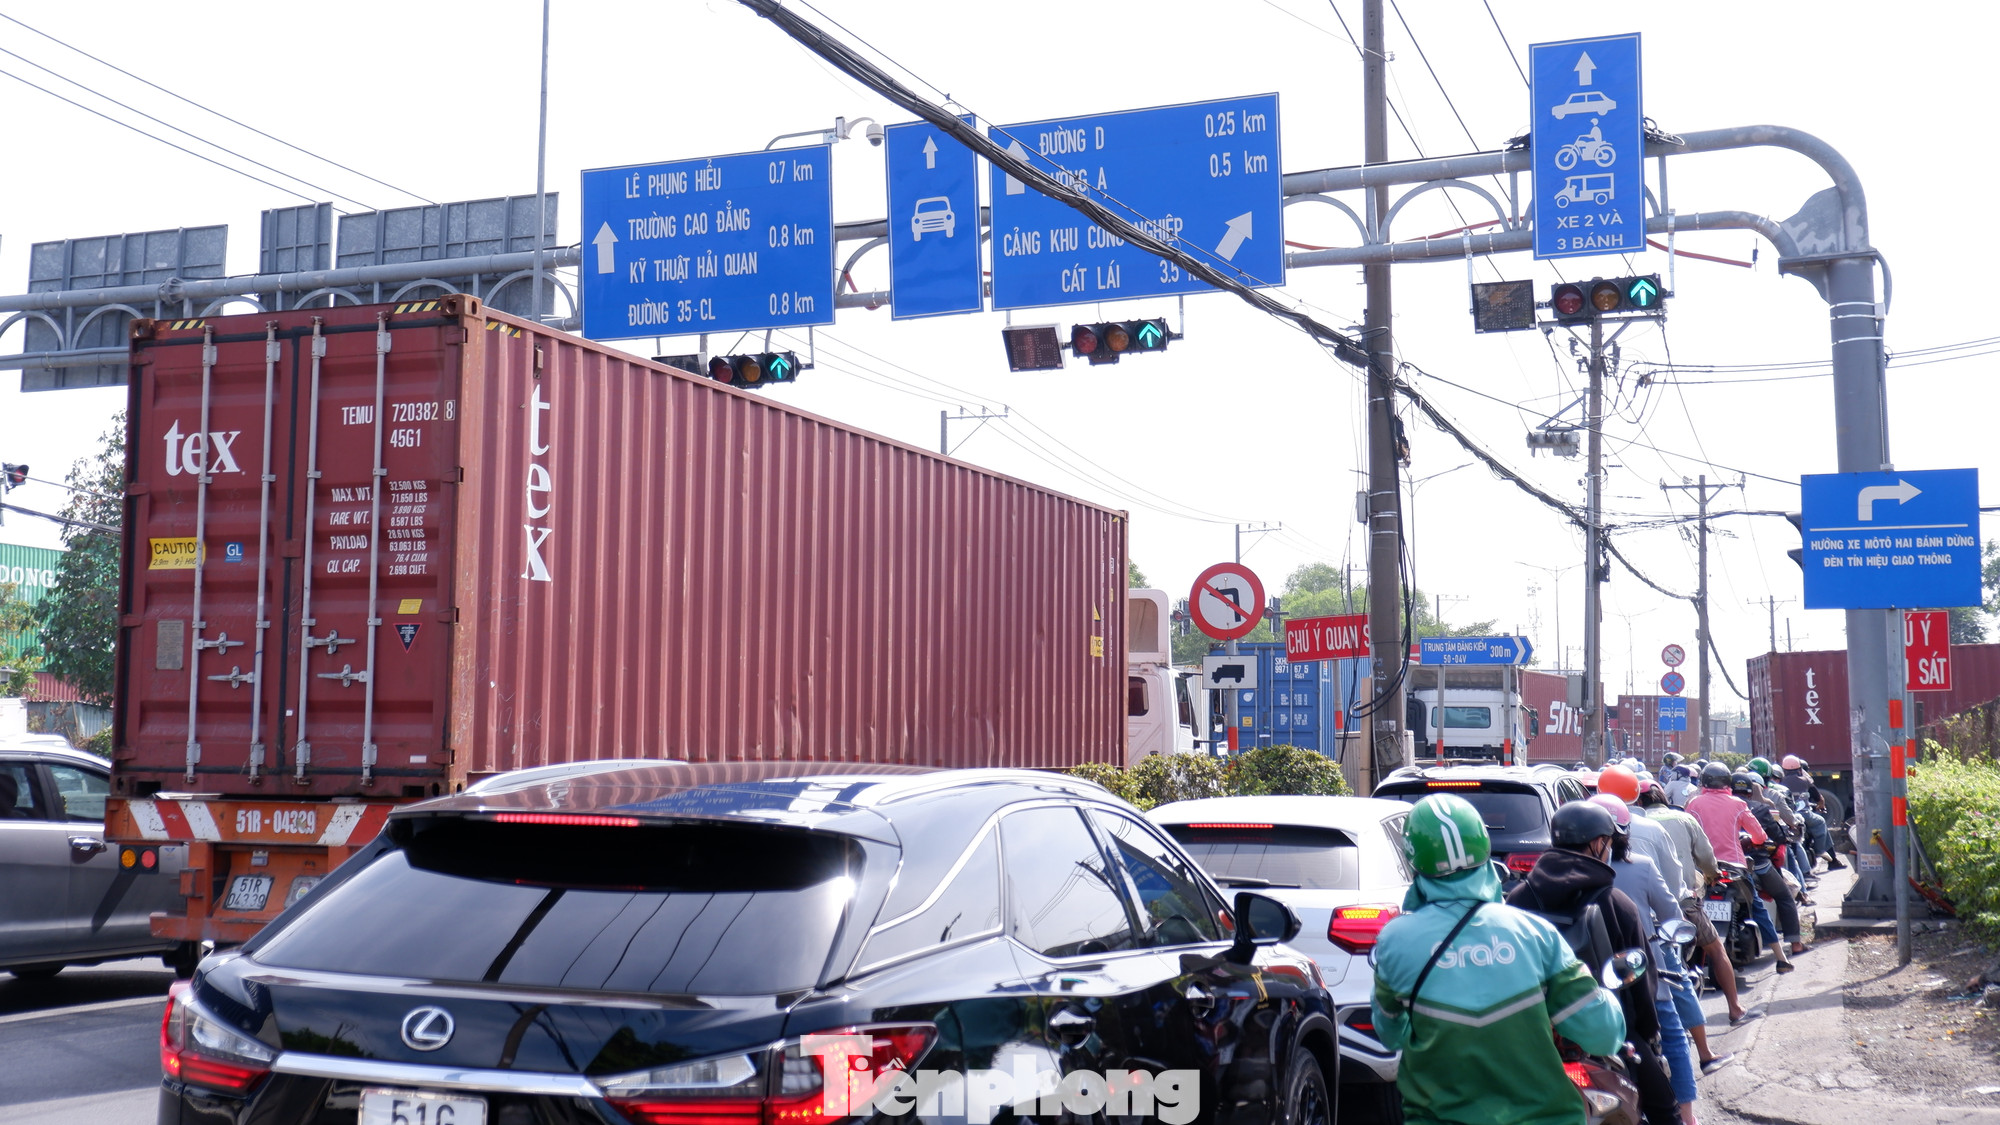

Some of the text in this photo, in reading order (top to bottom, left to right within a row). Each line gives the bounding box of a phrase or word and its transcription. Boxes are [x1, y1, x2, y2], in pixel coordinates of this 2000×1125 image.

[1243, 109, 1266, 133] km
[1039, 125, 1105, 156] ĐƯỜNG D
[793, 159, 813, 182] km
[1244, 150, 1268, 174] km
[625, 158, 722, 199] LÊ PHỤNG HIỂU
[1097, 166, 1108, 191] A
[628, 199, 751, 241] TRƯỜNG CAO ĐẲNG
[1556, 208, 1623, 229] XE 2 VÀ
[794, 224, 814, 246] km
[1003, 226, 1041, 257] CẢNG
[1050, 227, 1079, 253] KHU
[1556, 231, 1624, 250] 3 BÁNH
[630, 249, 758, 284] KỸ THUẬT HẢI QUAN
[1061, 263, 1088, 293] CÁT
[1097, 260, 1121, 290] LÁI
[627, 297, 669, 327] ĐƯỜNG
[794, 291, 815, 314] km
[341, 401, 454, 426] TEMU 720382 8
[162, 418, 242, 477] tex
[389, 428, 421, 448] 45G1
[520, 383, 554, 582] tex
[331, 487, 374, 503] MAX. WT.
[329, 510, 370, 526] TARE WT.
[154, 541, 242, 556] CAUTIO GL
[330, 535, 368, 550] PAYLOAD
[1847, 539, 1861, 550] XE
[1864, 536, 1892, 549] MÔTÔ
[1895, 537, 1912, 549] HAI
[1916, 534, 1944, 548] BÁNH
[342, 559, 361, 573] CAP.
[1823, 553, 1952, 569] ĐÈN TÍN HIỆU GIAO THÔNG
[1288, 622, 1310, 654] CHÚ
[1313, 622, 1321, 652] Ý
[1325, 625, 1359, 651] QUAN
[1920, 613, 1931, 647] Ý
[1424, 642, 1444, 652] TRUNG
[1444, 641, 1457, 652] TÂM
[1490, 645, 1504, 658] 300
[1918, 650, 1947, 685] SÁT
[1805, 667, 1823, 725] tex
[240, 878, 262, 893] 51R
[1430, 934, 1516, 969] Grab
